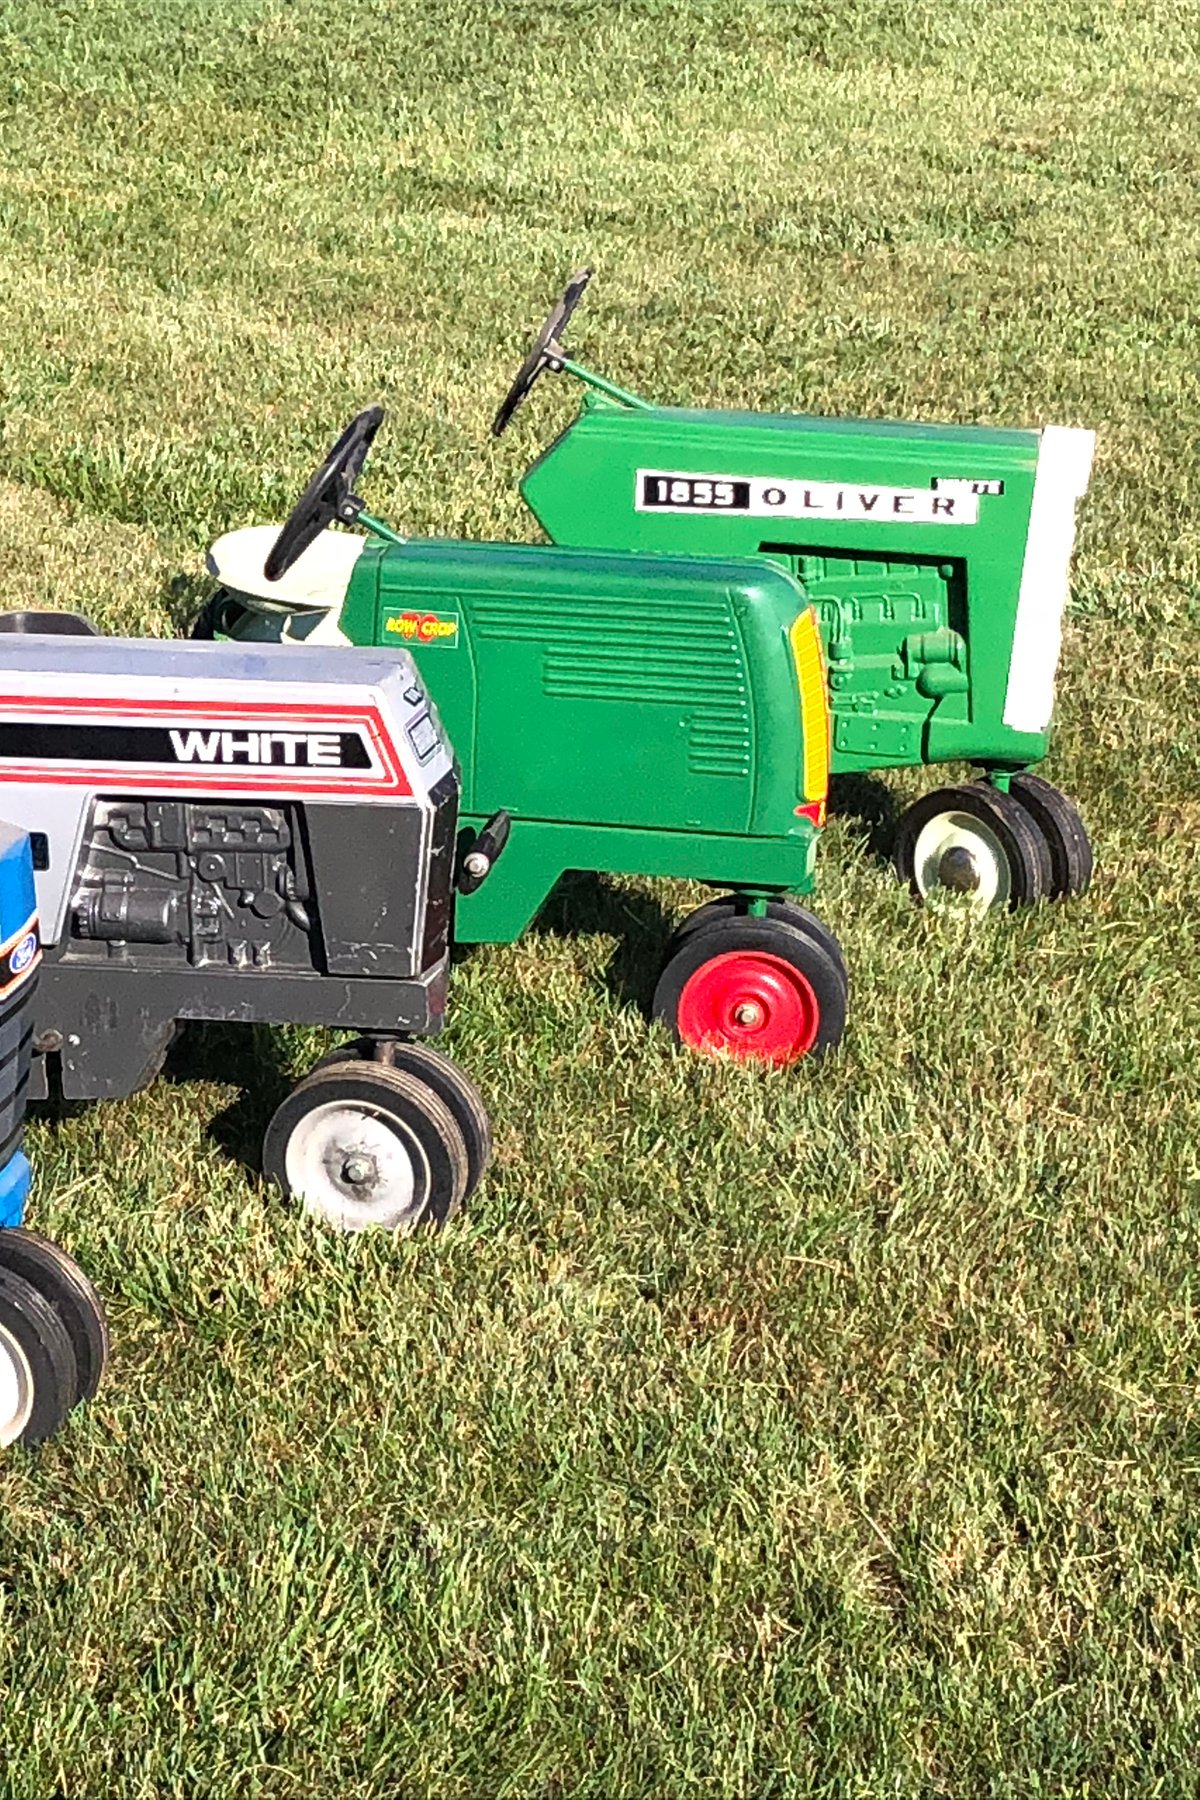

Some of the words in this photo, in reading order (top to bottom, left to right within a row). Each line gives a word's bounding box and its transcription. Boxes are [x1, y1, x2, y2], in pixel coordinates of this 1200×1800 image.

[657, 480, 734, 505] 1855
[762, 487, 955, 516] OLIVER
[386, 617, 418, 633] ROW
[421, 621, 457, 635] CROP
[169, 730, 341, 765] WHITE
